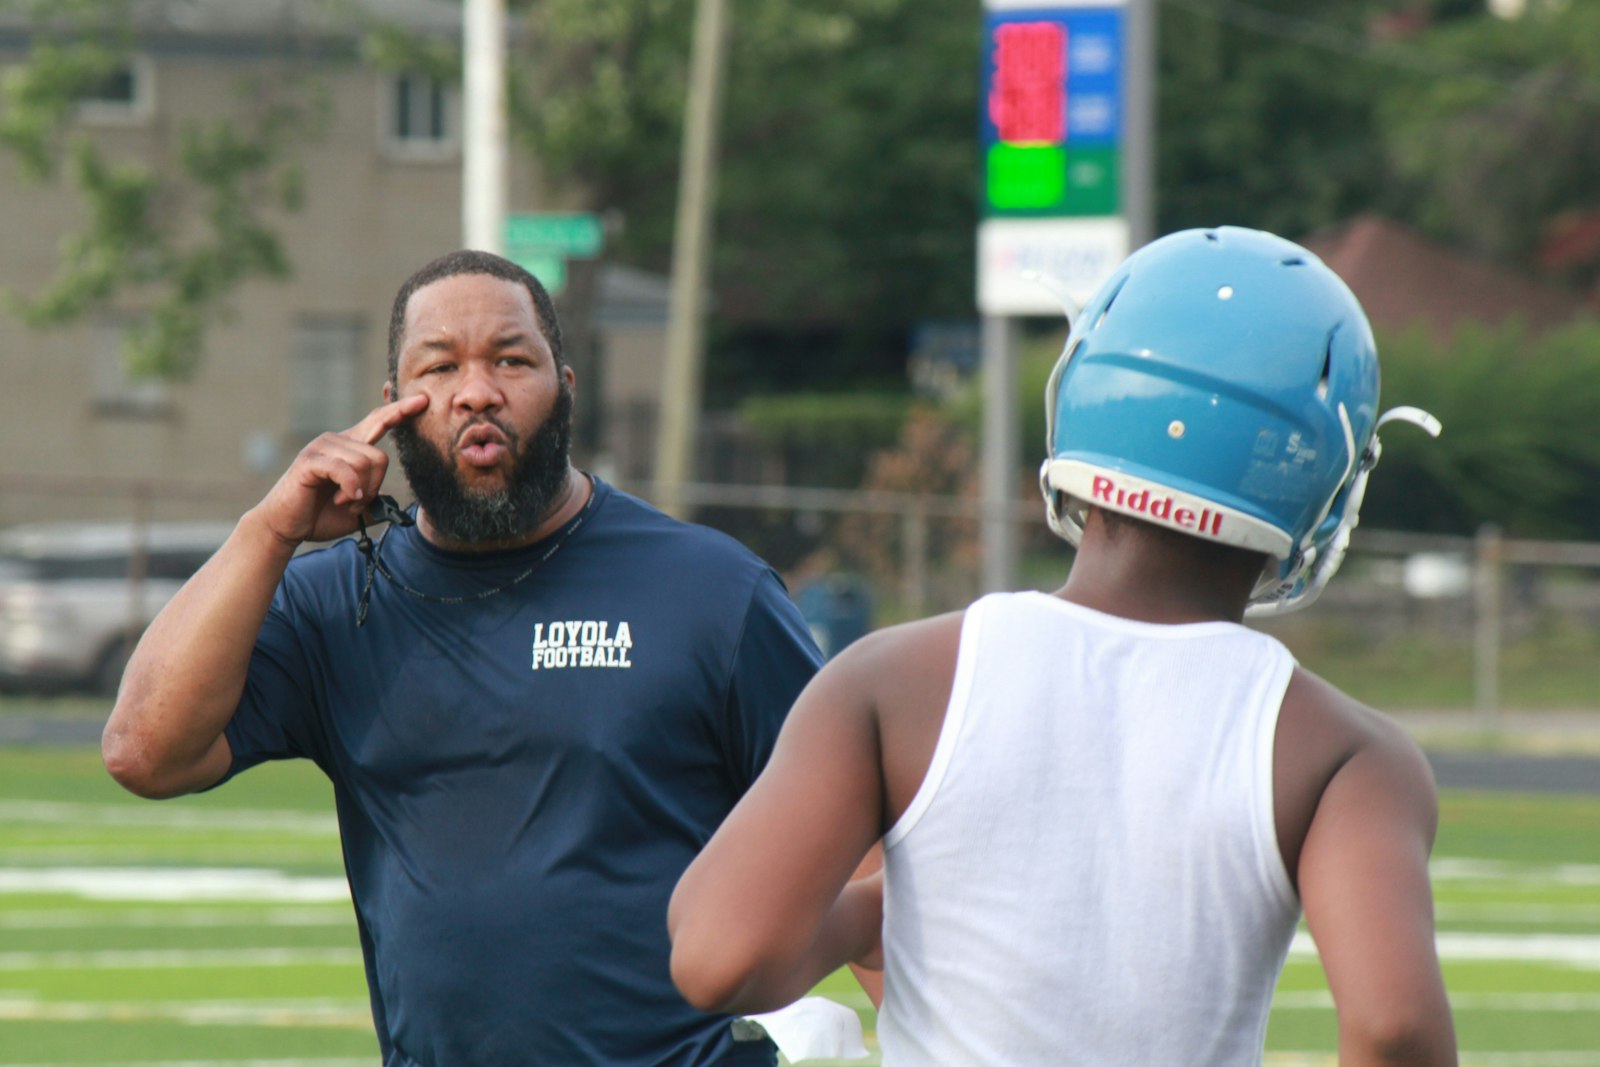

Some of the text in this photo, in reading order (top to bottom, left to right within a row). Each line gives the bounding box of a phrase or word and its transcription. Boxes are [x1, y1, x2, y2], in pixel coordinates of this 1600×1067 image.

[1092, 475, 1223, 536] Riddell
[533, 620, 632, 648] LOYOLA
[532, 646, 631, 670] FOOTBALL
